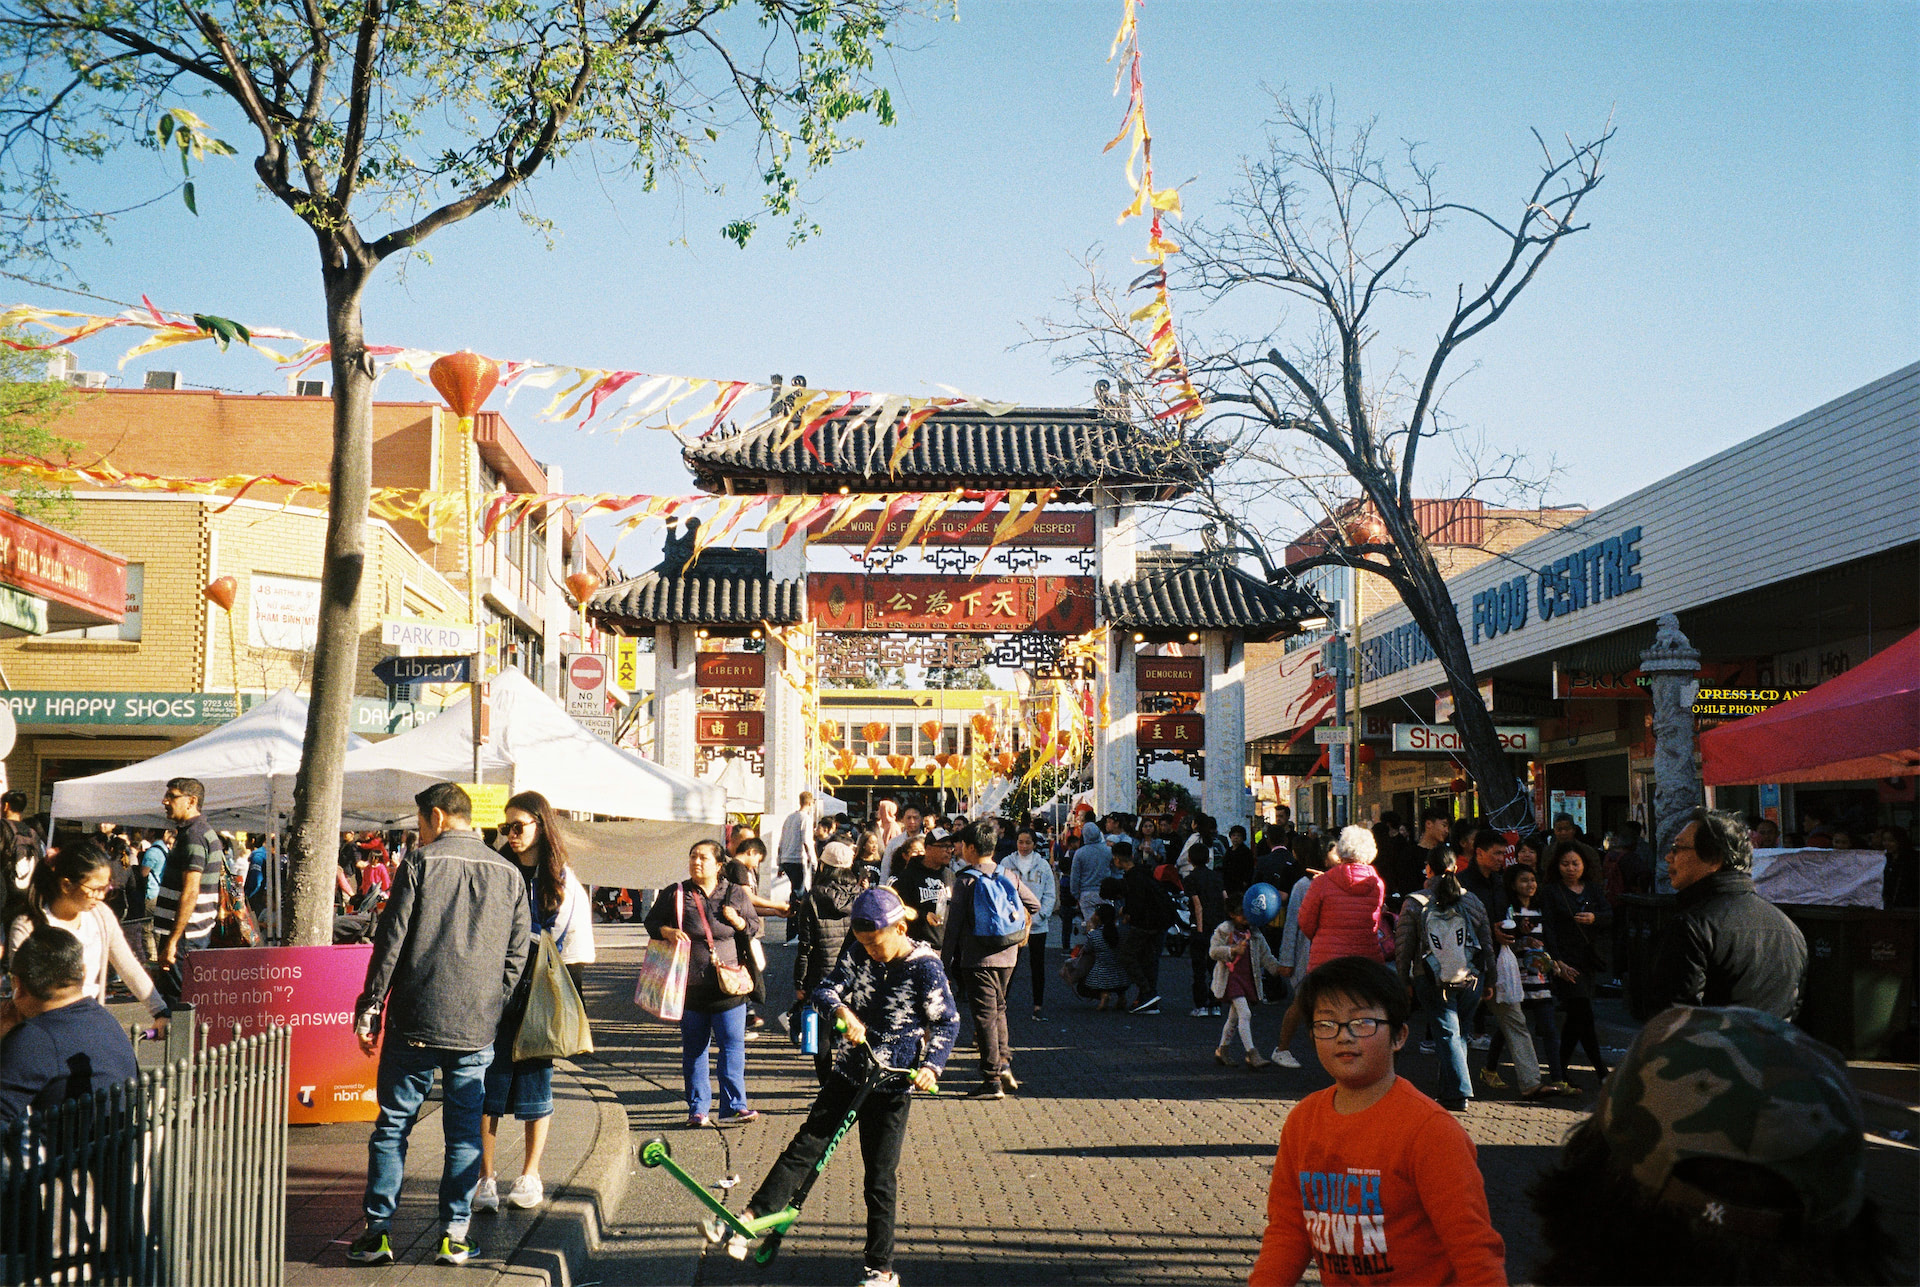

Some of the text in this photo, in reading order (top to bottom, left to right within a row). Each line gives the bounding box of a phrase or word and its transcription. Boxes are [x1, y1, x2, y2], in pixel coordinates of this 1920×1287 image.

[851, 522, 878, 532] WORL
[942, 523, 954, 532] TO
[1033, 523, 1076, 534] RESPECT
[1472, 525, 1642, 645] FOOD CENTRE
[392, 624, 461, 648] PARK RD
[394, 655, 462, 681] Library
[619, 650, 634, 682] TAX
[708, 665, 753, 676] LIBERTY
[1145, 669, 1193, 679] DEMOCRACY
[578, 692, 594, 701] NO
[1696, 689, 1748, 701] XPRESS
[1750, 689, 1780, 701] LCD
[45, 698, 117, 717] HAPPY
[125, 699, 196, 718] SHOES
[571, 701, 599, 709] ENTRY
[1691, 704, 1727, 715] OBILE
[359, 707, 394, 725] DAY
[193, 963, 303, 985] Got questions
[191, 992, 210, 1006] on
[213, 988, 238, 1005] the
[217, 1012, 253, 1029] have
[257, 1010, 286, 1027] the
[1299, 1171, 1385, 1216] TOUCH
[1303, 1209, 1388, 1256] DOWN
[1325, 1253, 1351, 1276] THE
[1352, 1252, 1395, 1277] BALL
